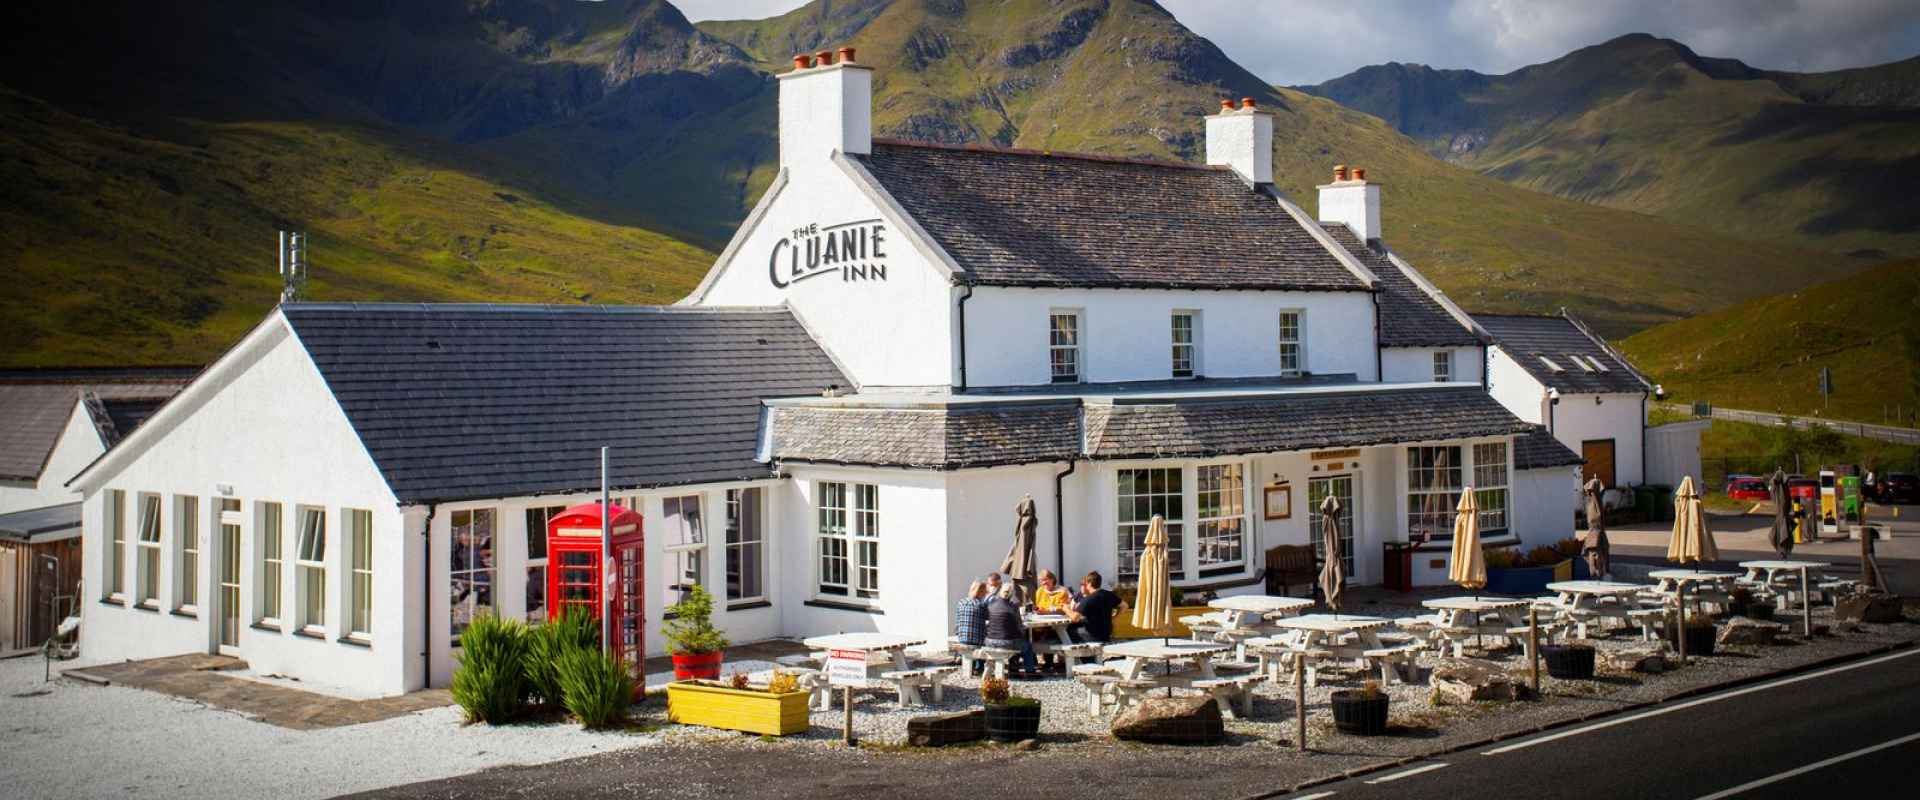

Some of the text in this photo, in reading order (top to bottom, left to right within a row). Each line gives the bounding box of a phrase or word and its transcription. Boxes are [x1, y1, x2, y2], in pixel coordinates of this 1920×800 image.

[792, 222, 818, 240] THE
[769, 225, 887, 289] CLUANIE
[843, 263, 887, 282] INN
[840, 651, 866, 660] PARKING
